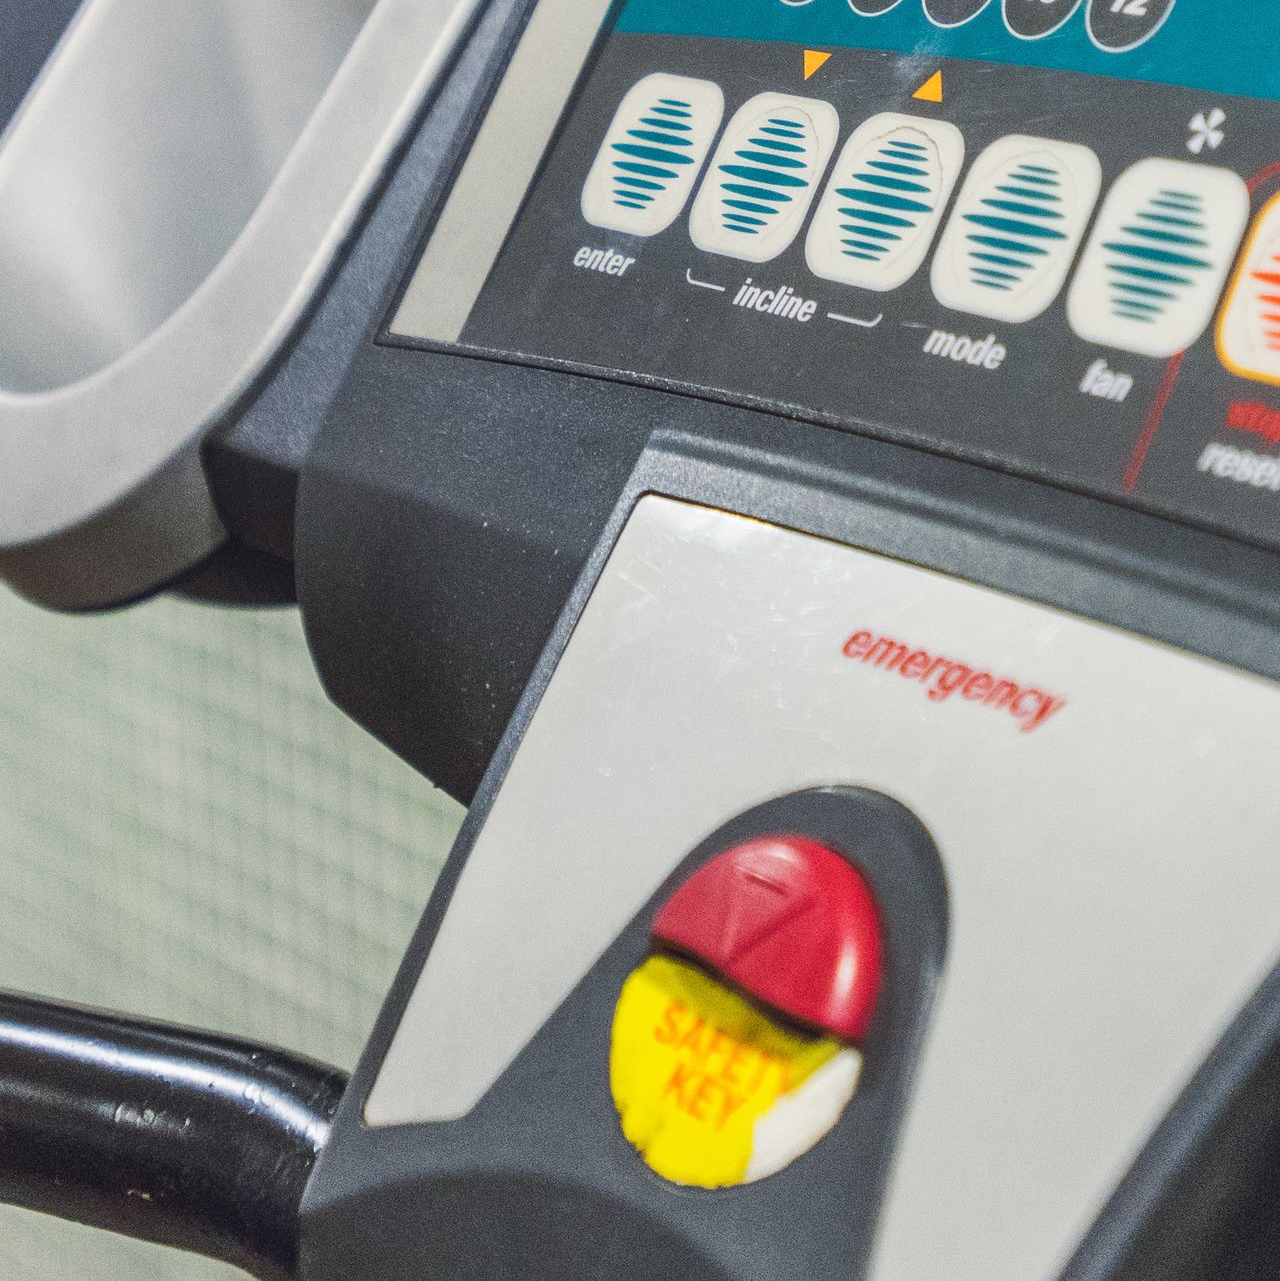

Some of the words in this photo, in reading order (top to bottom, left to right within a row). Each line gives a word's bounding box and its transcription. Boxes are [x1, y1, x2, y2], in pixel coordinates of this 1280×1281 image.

[573, 244, 635, 278] enter
[732, 279, 817, 323] incline
[923, 326, 1006, 370] mode
[1080, 358, 1133, 402] fan
[841, 626, 1070, 732] emergency
[664, 1062, 747, 1131] KEY
